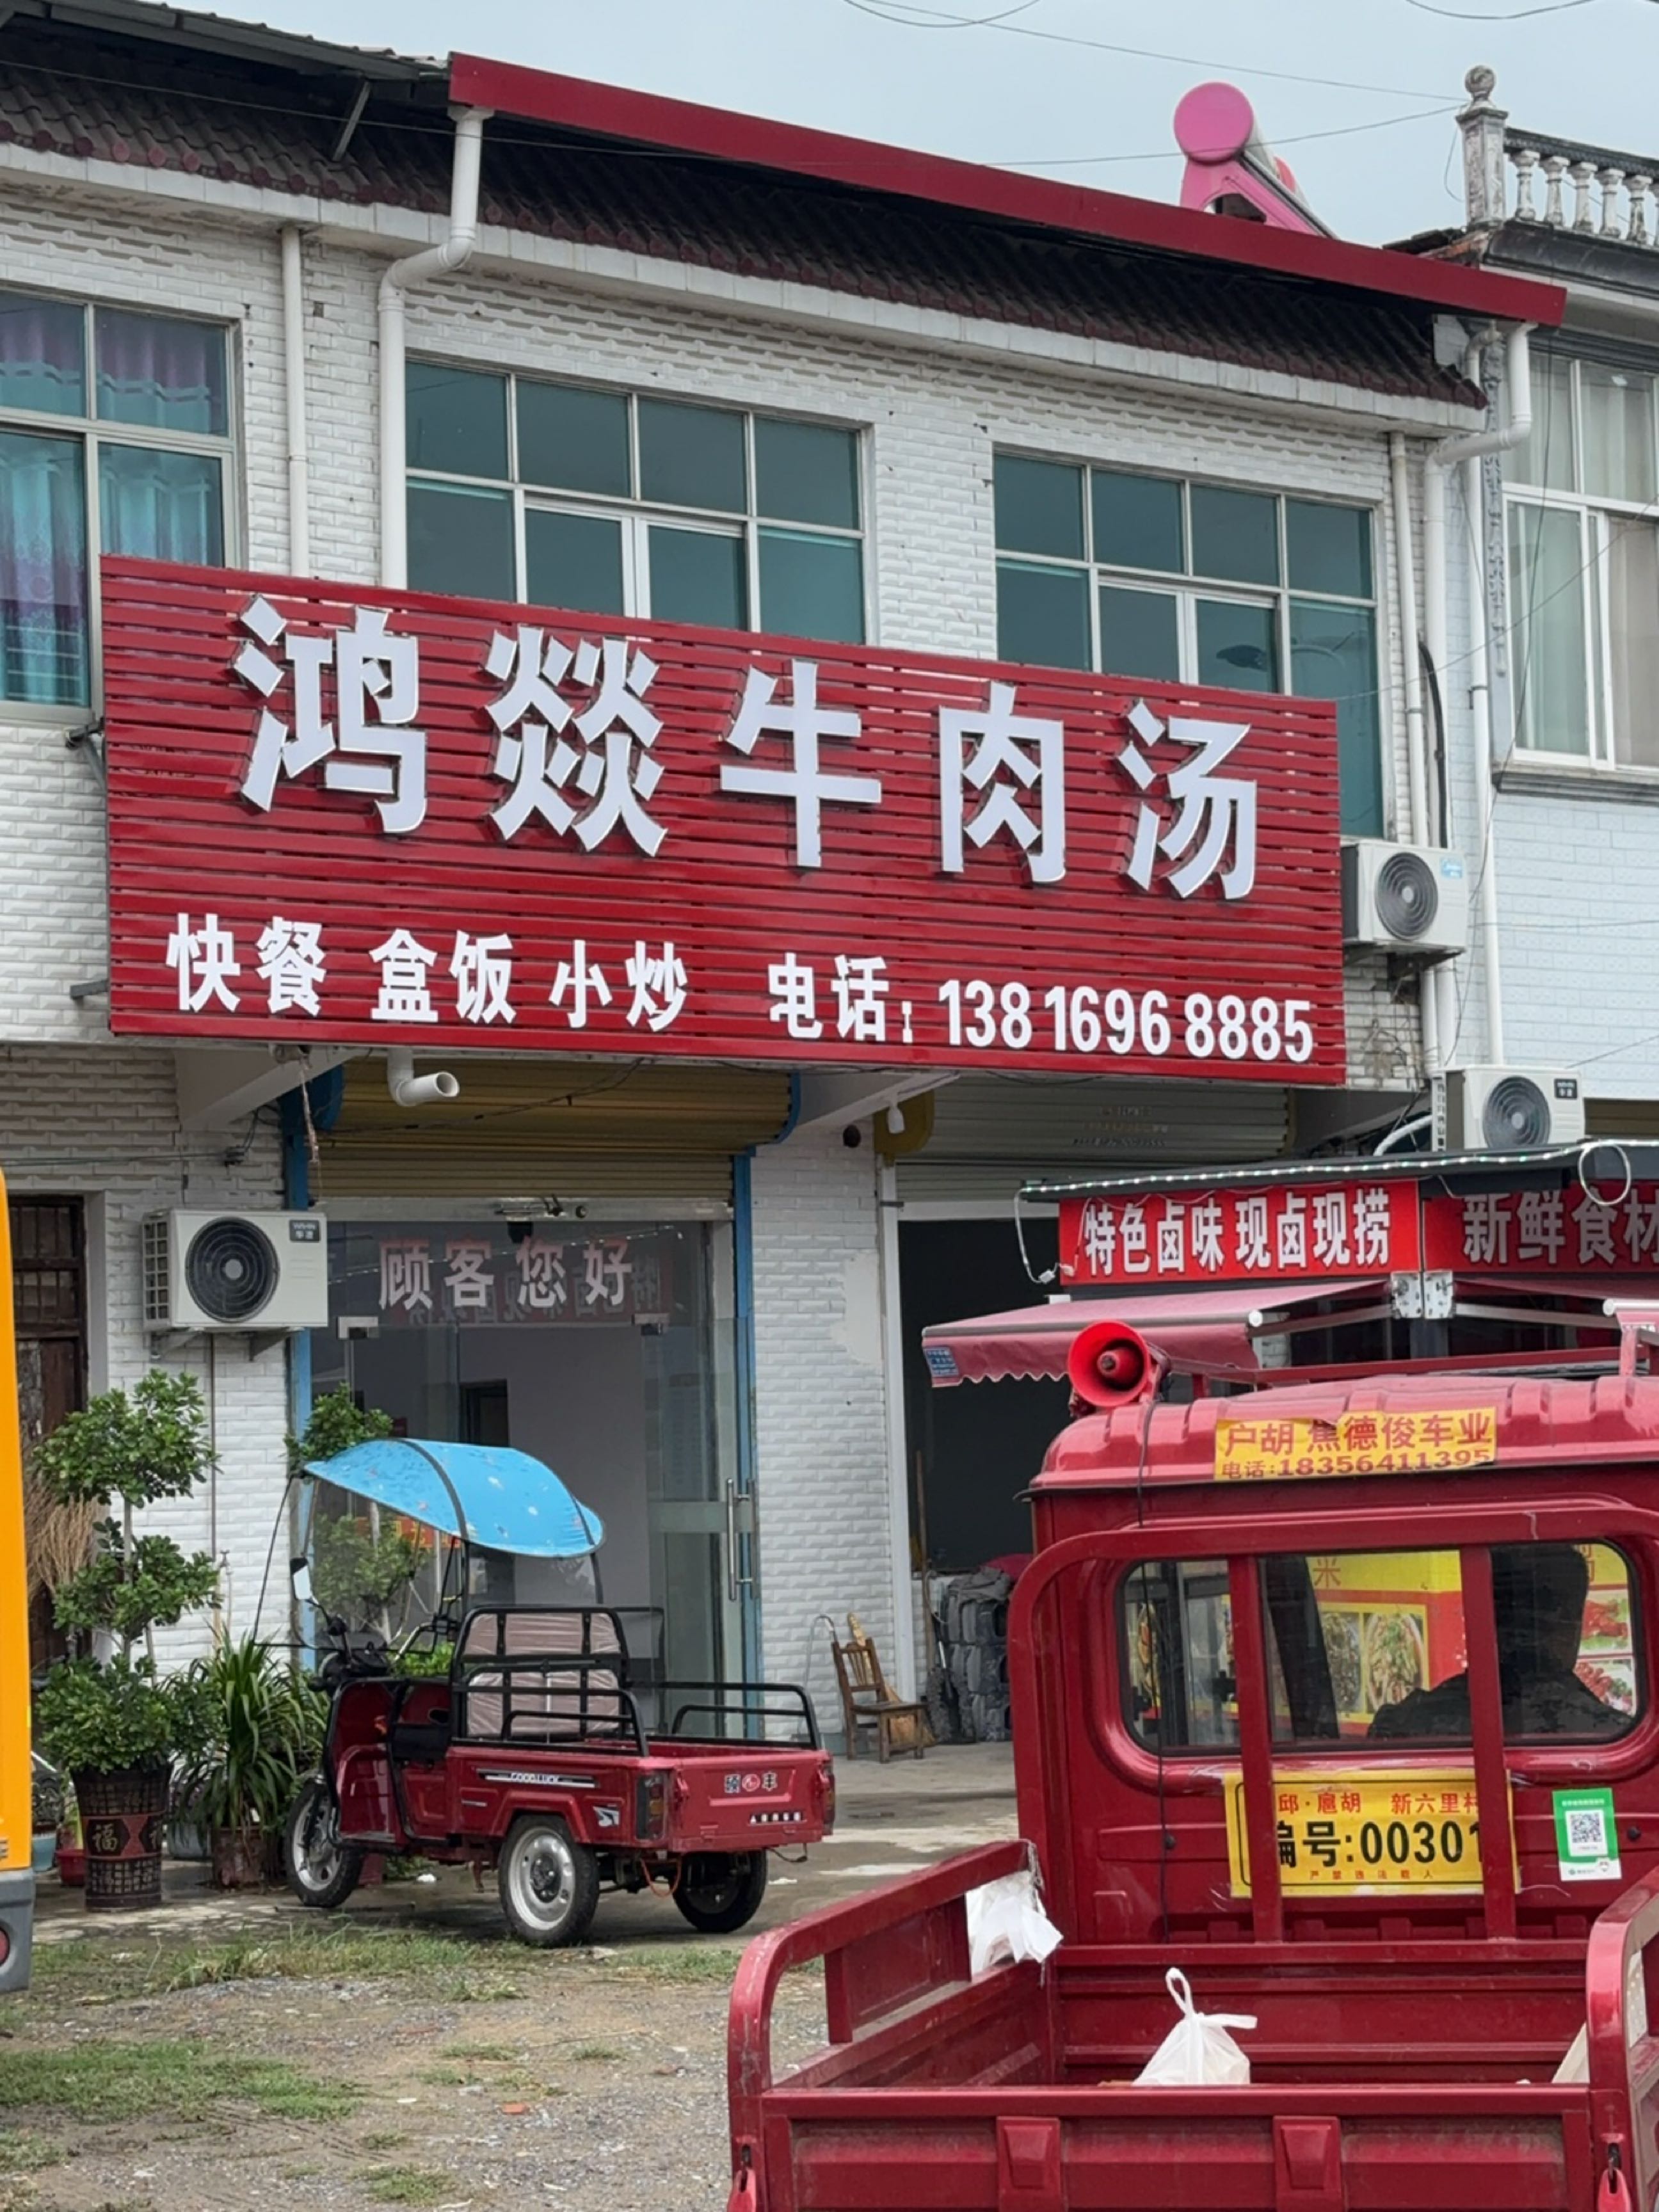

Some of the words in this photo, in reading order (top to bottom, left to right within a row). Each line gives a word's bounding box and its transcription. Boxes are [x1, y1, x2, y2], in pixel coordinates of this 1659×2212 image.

[234, 594, 1256, 900] 鸿燚牛肉汤
[166, 913, 326, 1017] 快餐
[369, 929, 516, 1023] 盒饭
[549, 939, 688, 1032] 小炒
[379, 1234, 632, 1311] 顾客您好
[1224, 1423, 1294, 1457] 户胡
